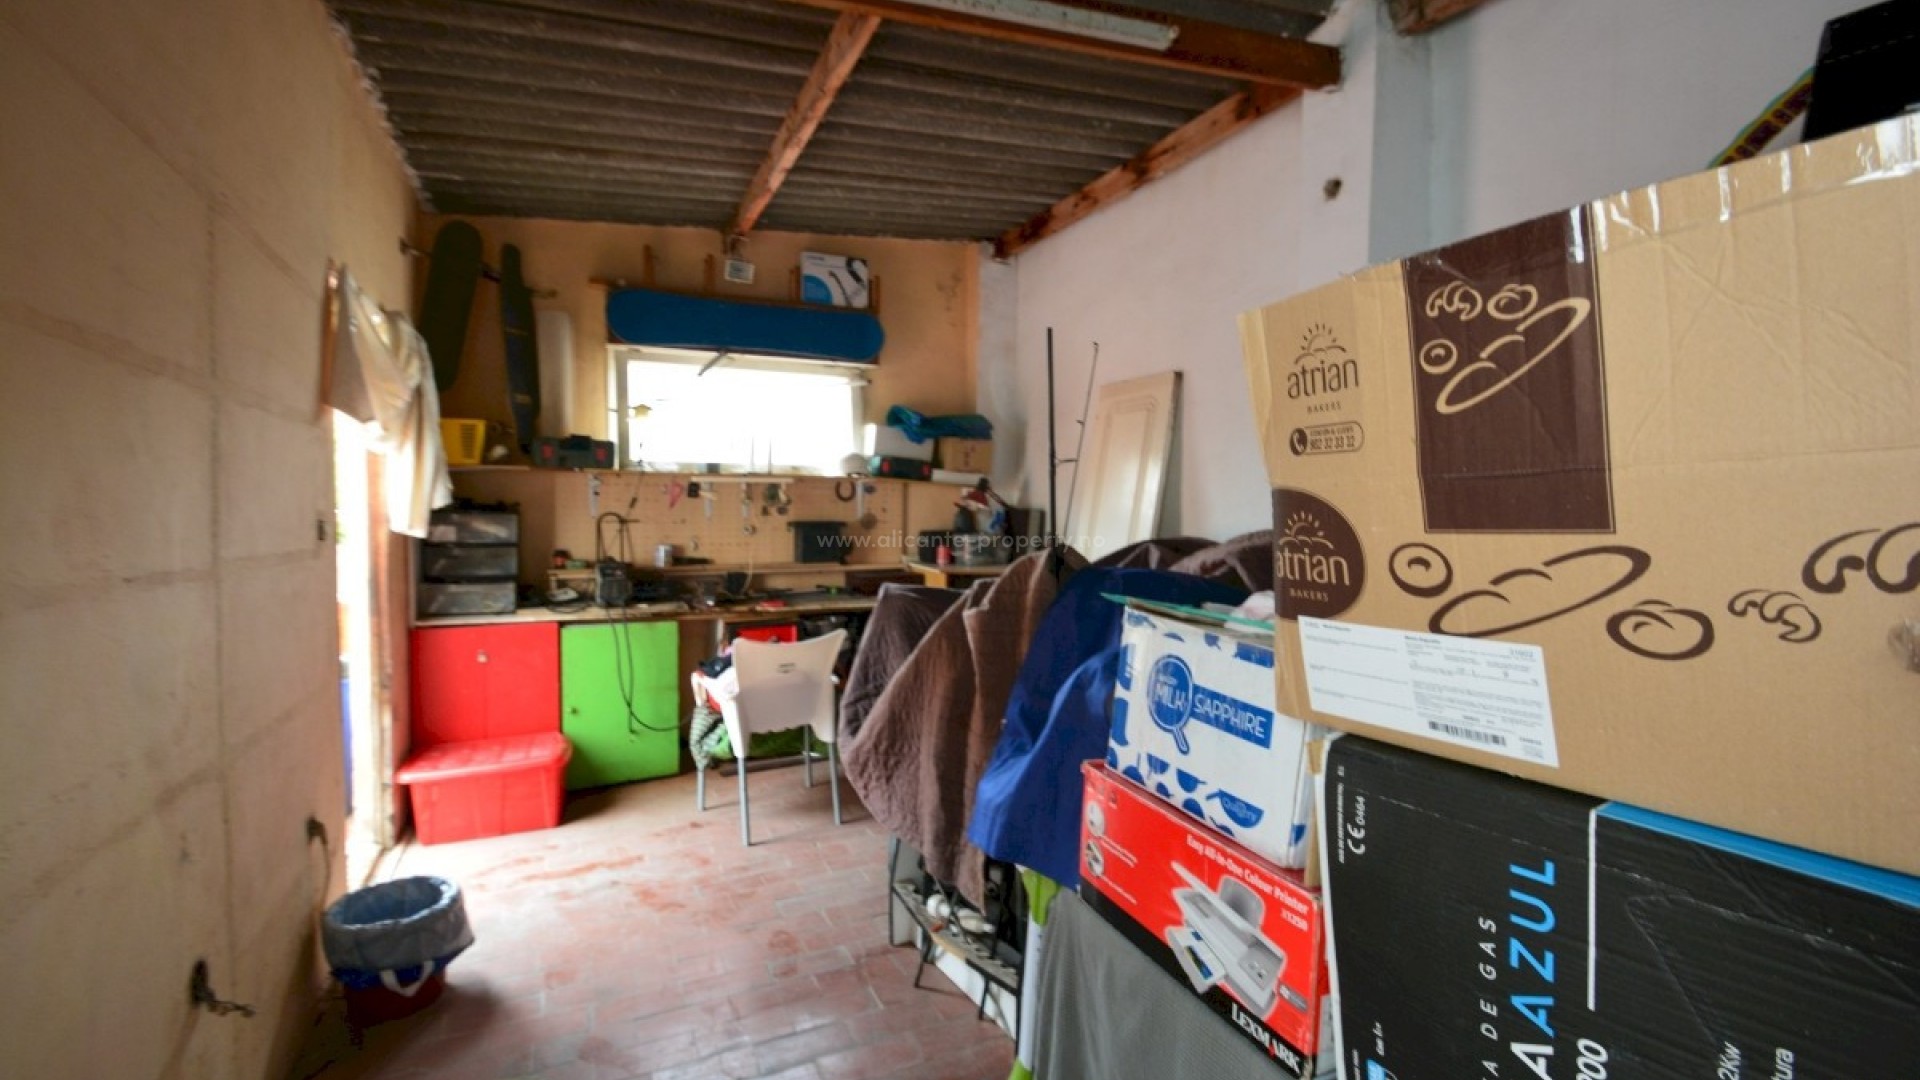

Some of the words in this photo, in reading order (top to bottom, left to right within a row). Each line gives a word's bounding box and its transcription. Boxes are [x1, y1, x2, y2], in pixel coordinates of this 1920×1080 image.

[1287, 359, 1359, 400] atrian
[1193, 693, 1267, 740] SAPPHIRE
[1273, 885, 1309, 915] Printer
[1477, 915, 1498, 982] GAS
[1231, 1001, 1301, 1075] LEXMARK
[1479, 998, 1499, 1042] DE
